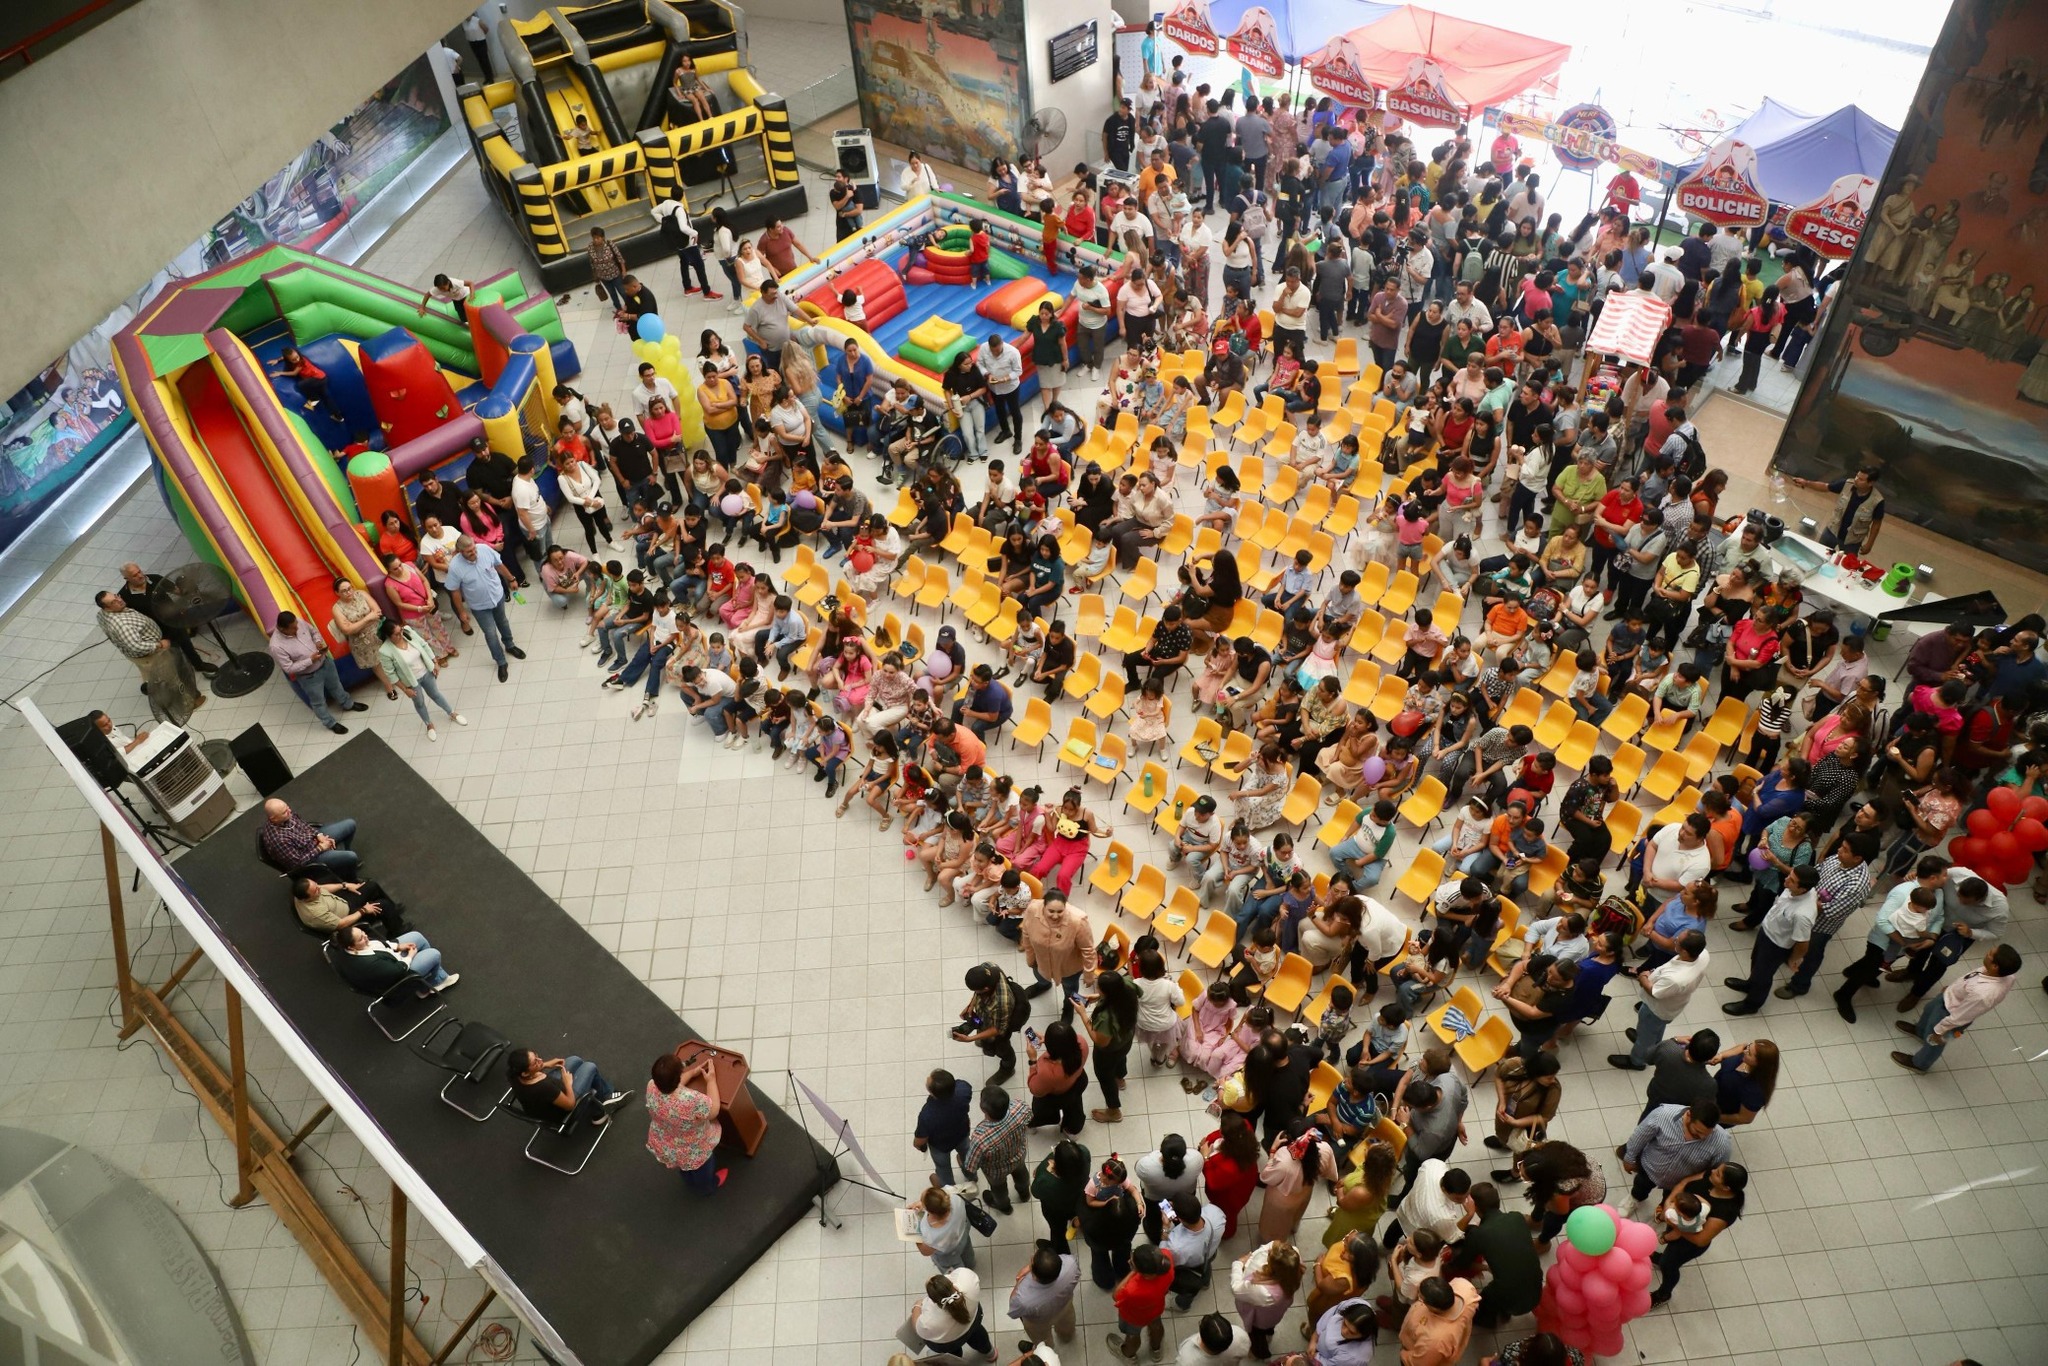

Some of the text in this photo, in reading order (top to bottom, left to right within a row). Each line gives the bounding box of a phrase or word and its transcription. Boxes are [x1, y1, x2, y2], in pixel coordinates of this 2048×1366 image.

[1167, 24, 1216, 52] DARDOS
[1238, 52, 1277, 75] BLANCO
[1240, 43, 1273, 64] TIRO AL
[1313, 75, 1372, 103] CANICAS
[1389, 98, 1458, 124] BASQUET
[1683, 192, 1761, 219] BOLICHE
[1803, 222, 1857, 249] PESC
